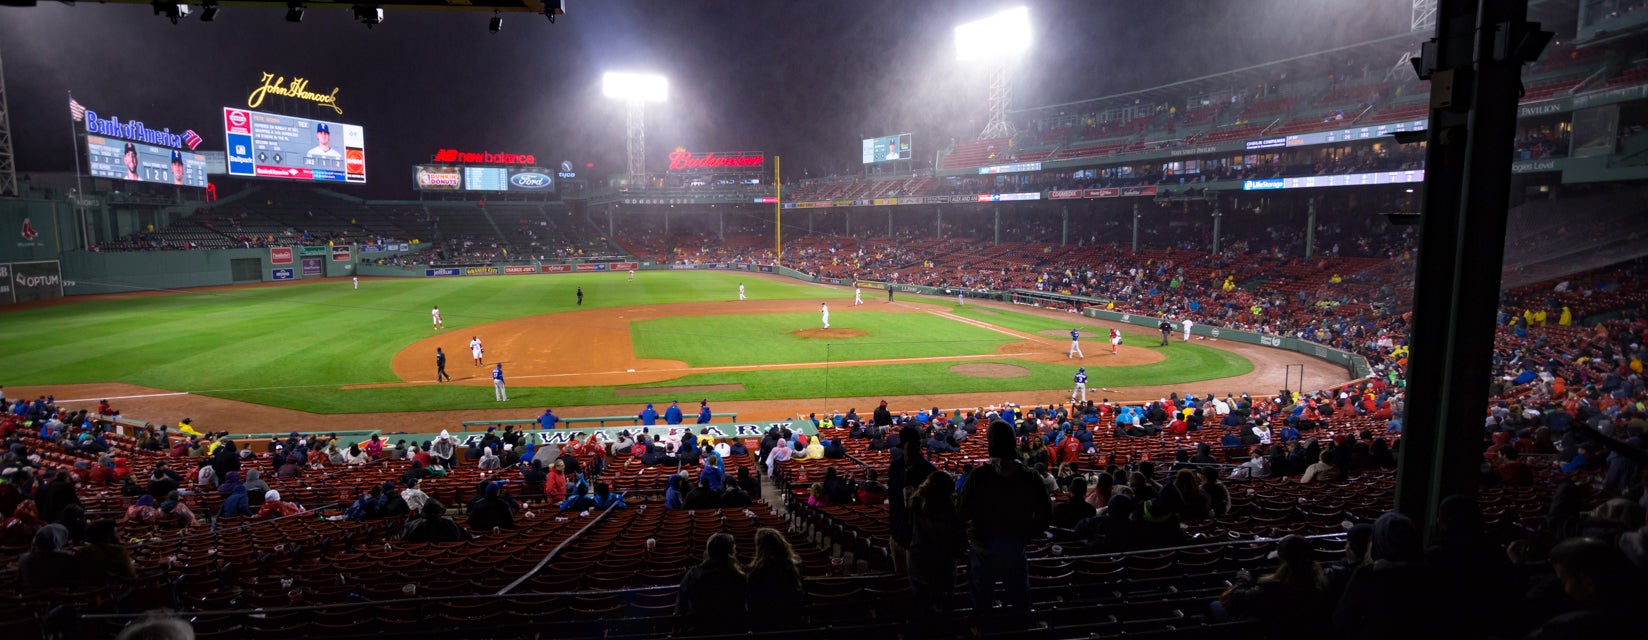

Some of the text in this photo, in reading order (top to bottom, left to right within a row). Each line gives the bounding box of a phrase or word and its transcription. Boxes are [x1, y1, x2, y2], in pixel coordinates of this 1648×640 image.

[248, 71, 343, 115] John Hancock
[1521, 104, 1561, 116] PAVILION
[85, 110, 182, 148] Bank of America
[458, 153, 483, 163] new
[484, 151, 535, 164] balance
[668, 151, 764, 170] Budweiser
[1533, 159, 1555, 169] Level
[154, 170, 160, 180] 2
[163, 171, 168, 181] 0
[518, 174, 543, 186] Ford
[434, 268, 453, 276] jetBlue
[26, 275, 59, 287] OPTUM
